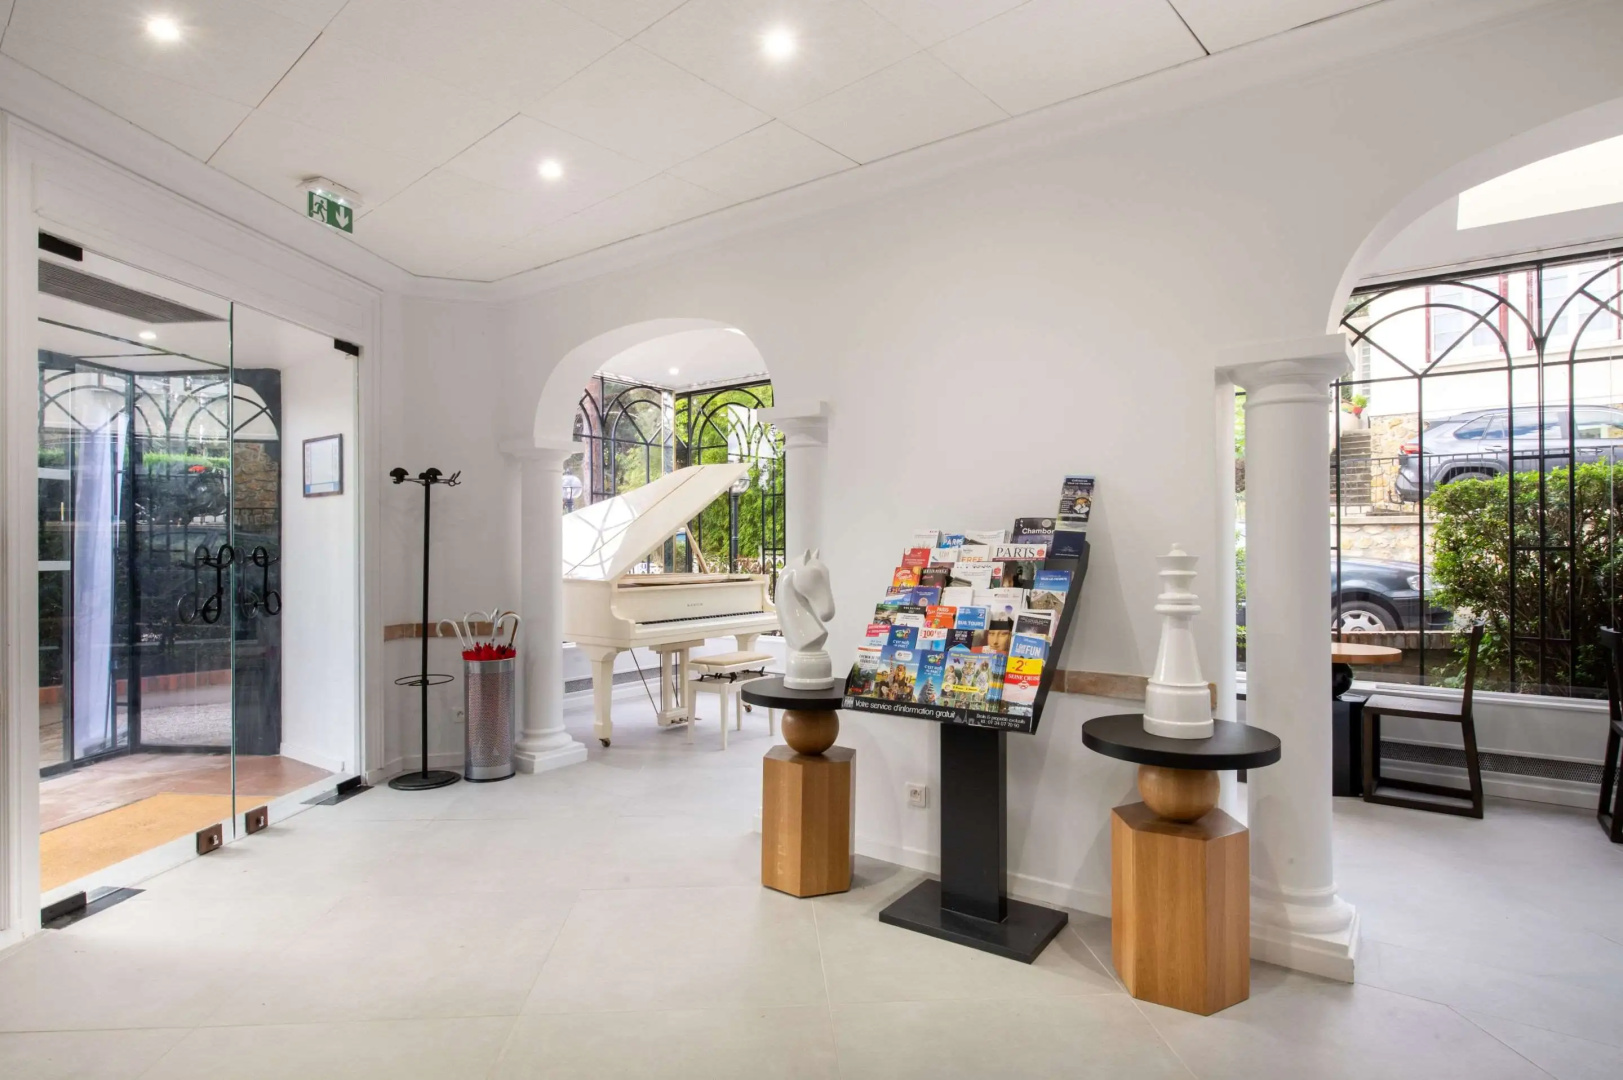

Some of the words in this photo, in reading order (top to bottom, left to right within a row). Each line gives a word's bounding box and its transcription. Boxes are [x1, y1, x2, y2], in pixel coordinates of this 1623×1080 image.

[996, 547, 1035, 558] PARIS
[1025, 645, 1042, 656] FUN
[855, 700, 869, 708] Votre
[870, 703, 892, 711] service
[893, 704, 934, 716] d'information
[935, 709, 956, 719] gratuit
